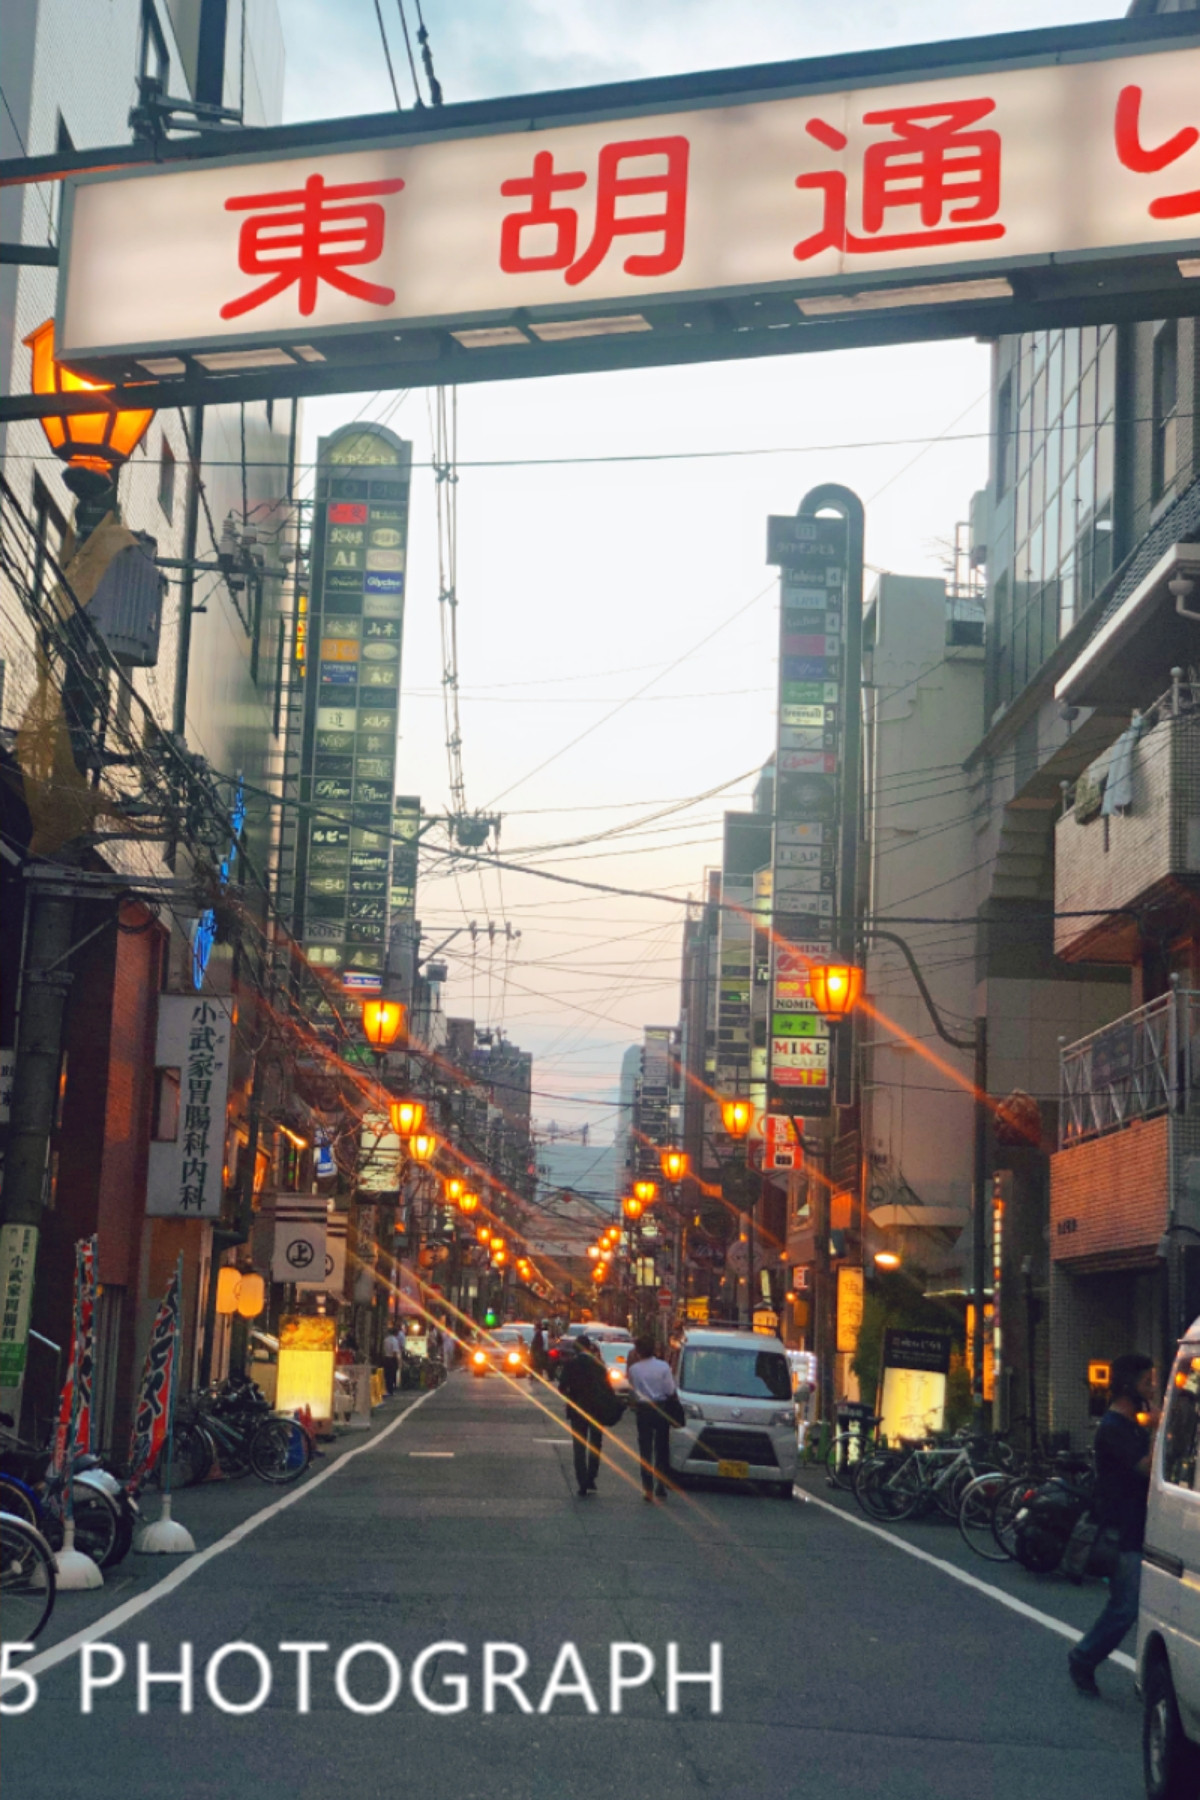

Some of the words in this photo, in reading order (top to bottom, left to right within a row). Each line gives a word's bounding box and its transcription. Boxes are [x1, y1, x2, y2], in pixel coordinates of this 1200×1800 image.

[776, 998, 817, 1009] NOMIN
[774, 1041, 827, 1055] MIKE
[800, 1069, 824, 1085] 1F
[179, 1000, 217, 1211] 小武家胃腸科内科
